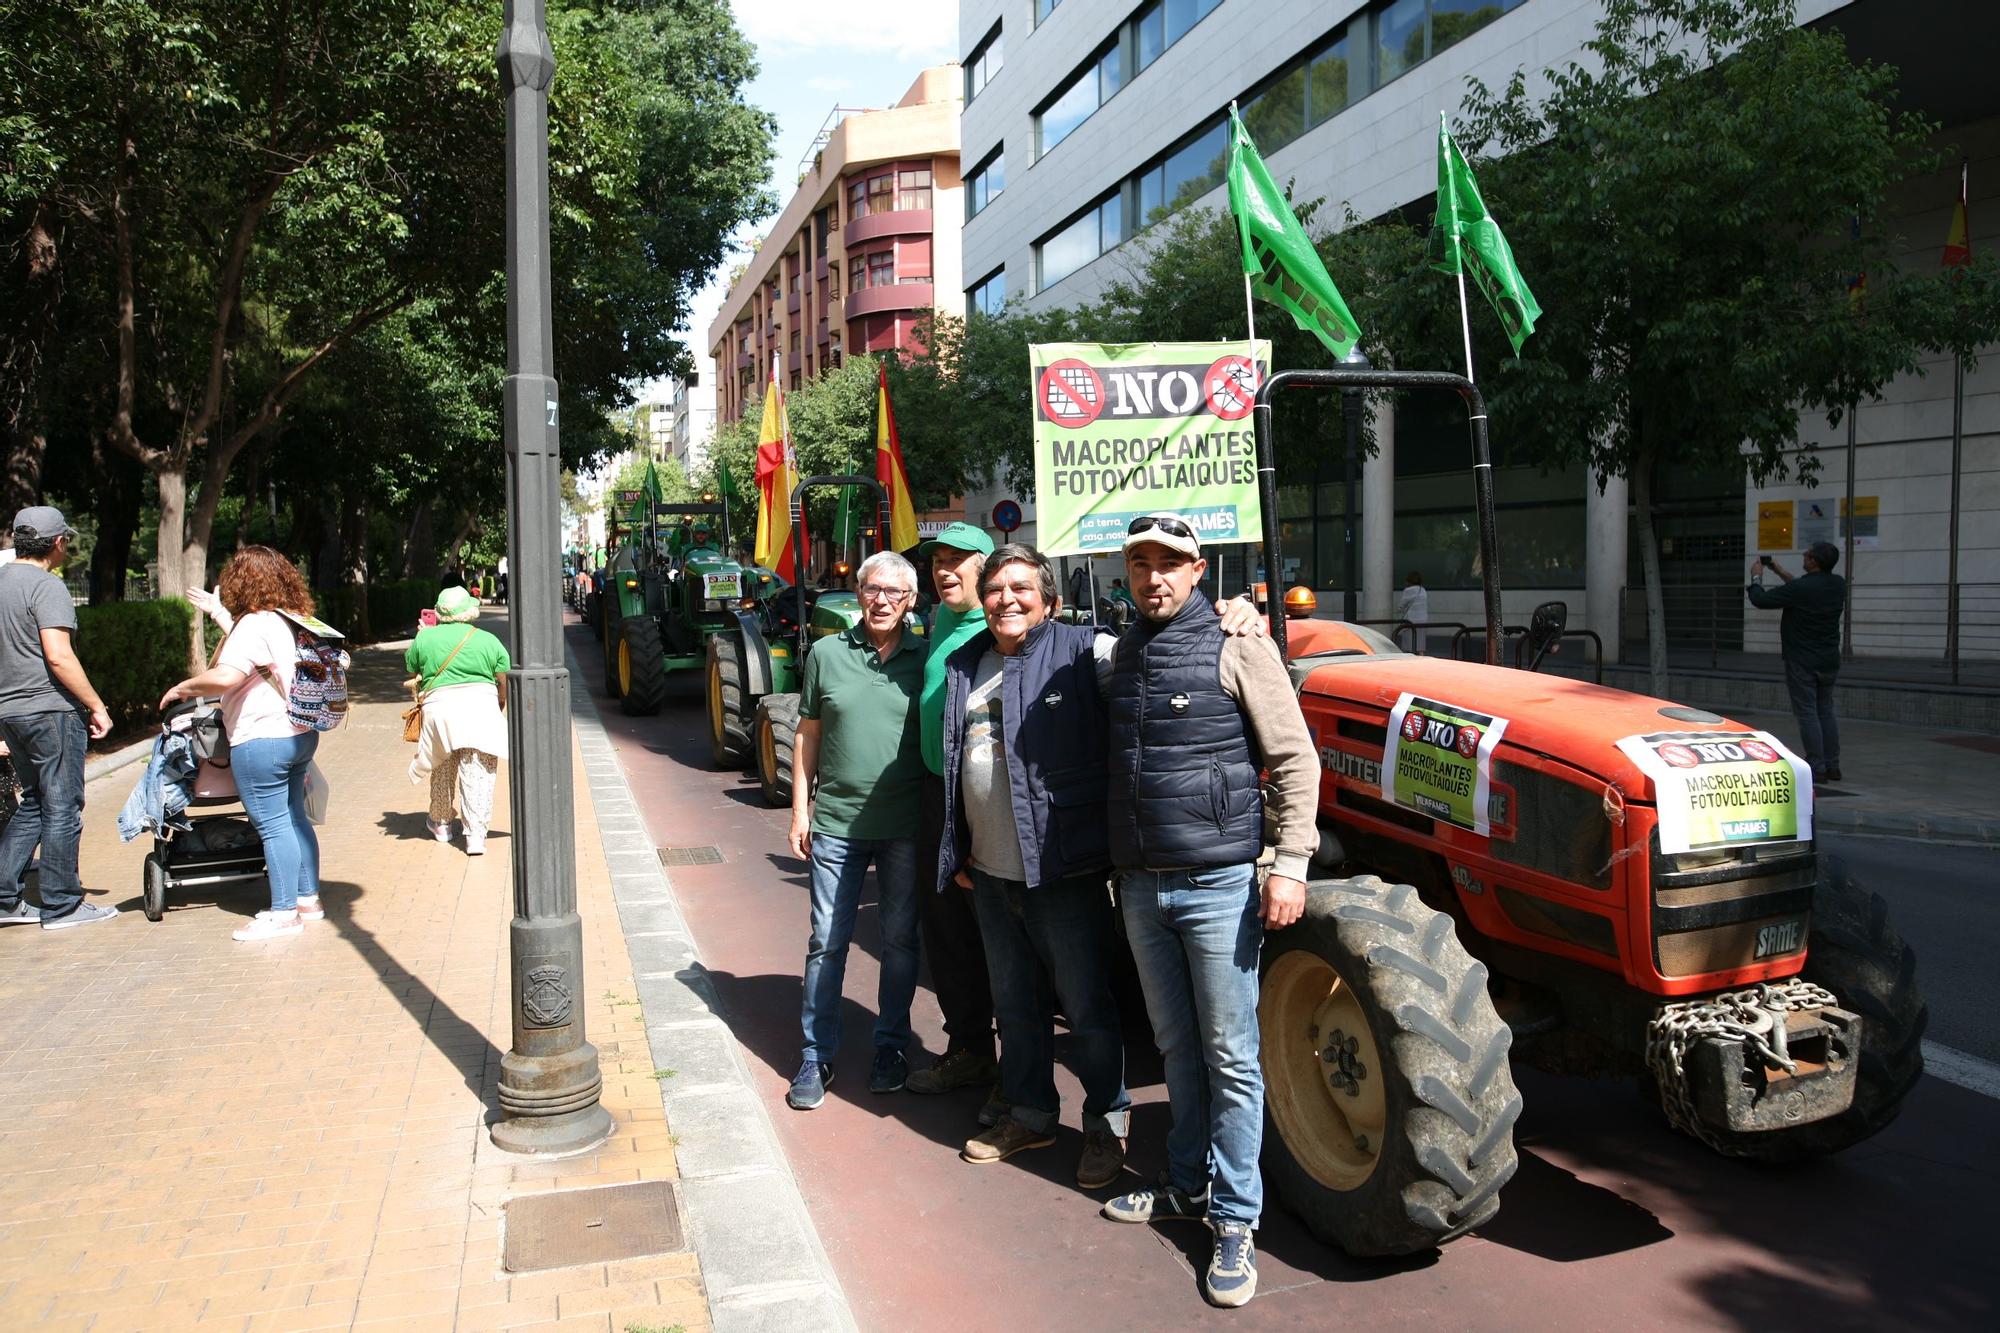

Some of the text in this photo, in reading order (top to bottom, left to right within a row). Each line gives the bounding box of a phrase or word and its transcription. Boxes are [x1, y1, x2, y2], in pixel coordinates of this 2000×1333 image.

[1108, 370, 1200, 415] NO
[1052, 431, 1254, 467] MACROPLANTES
[1053, 459, 1256, 496] FOTOVOLTAIQUES
[1081, 518, 1095, 528] La
[1096, 517, 1124, 528] terra,
[1082, 530, 1129, 541] casa nostr
[1422, 720, 1455, 748] NO
[1320, 746, 1383, 785] FRUTTET
[1399, 748, 1473, 782] MACROPLANTES
[1689, 742, 1746, 763] NO
[1398, 763, 1470, 797] FOTOVOLTAIQUES
[1685, 770, 1790, 793] MACROPLANTES
[1689, 788, 1791, 810] FOTOVOLTAIQUES
[1755, 921, 1799, 958] SAME
